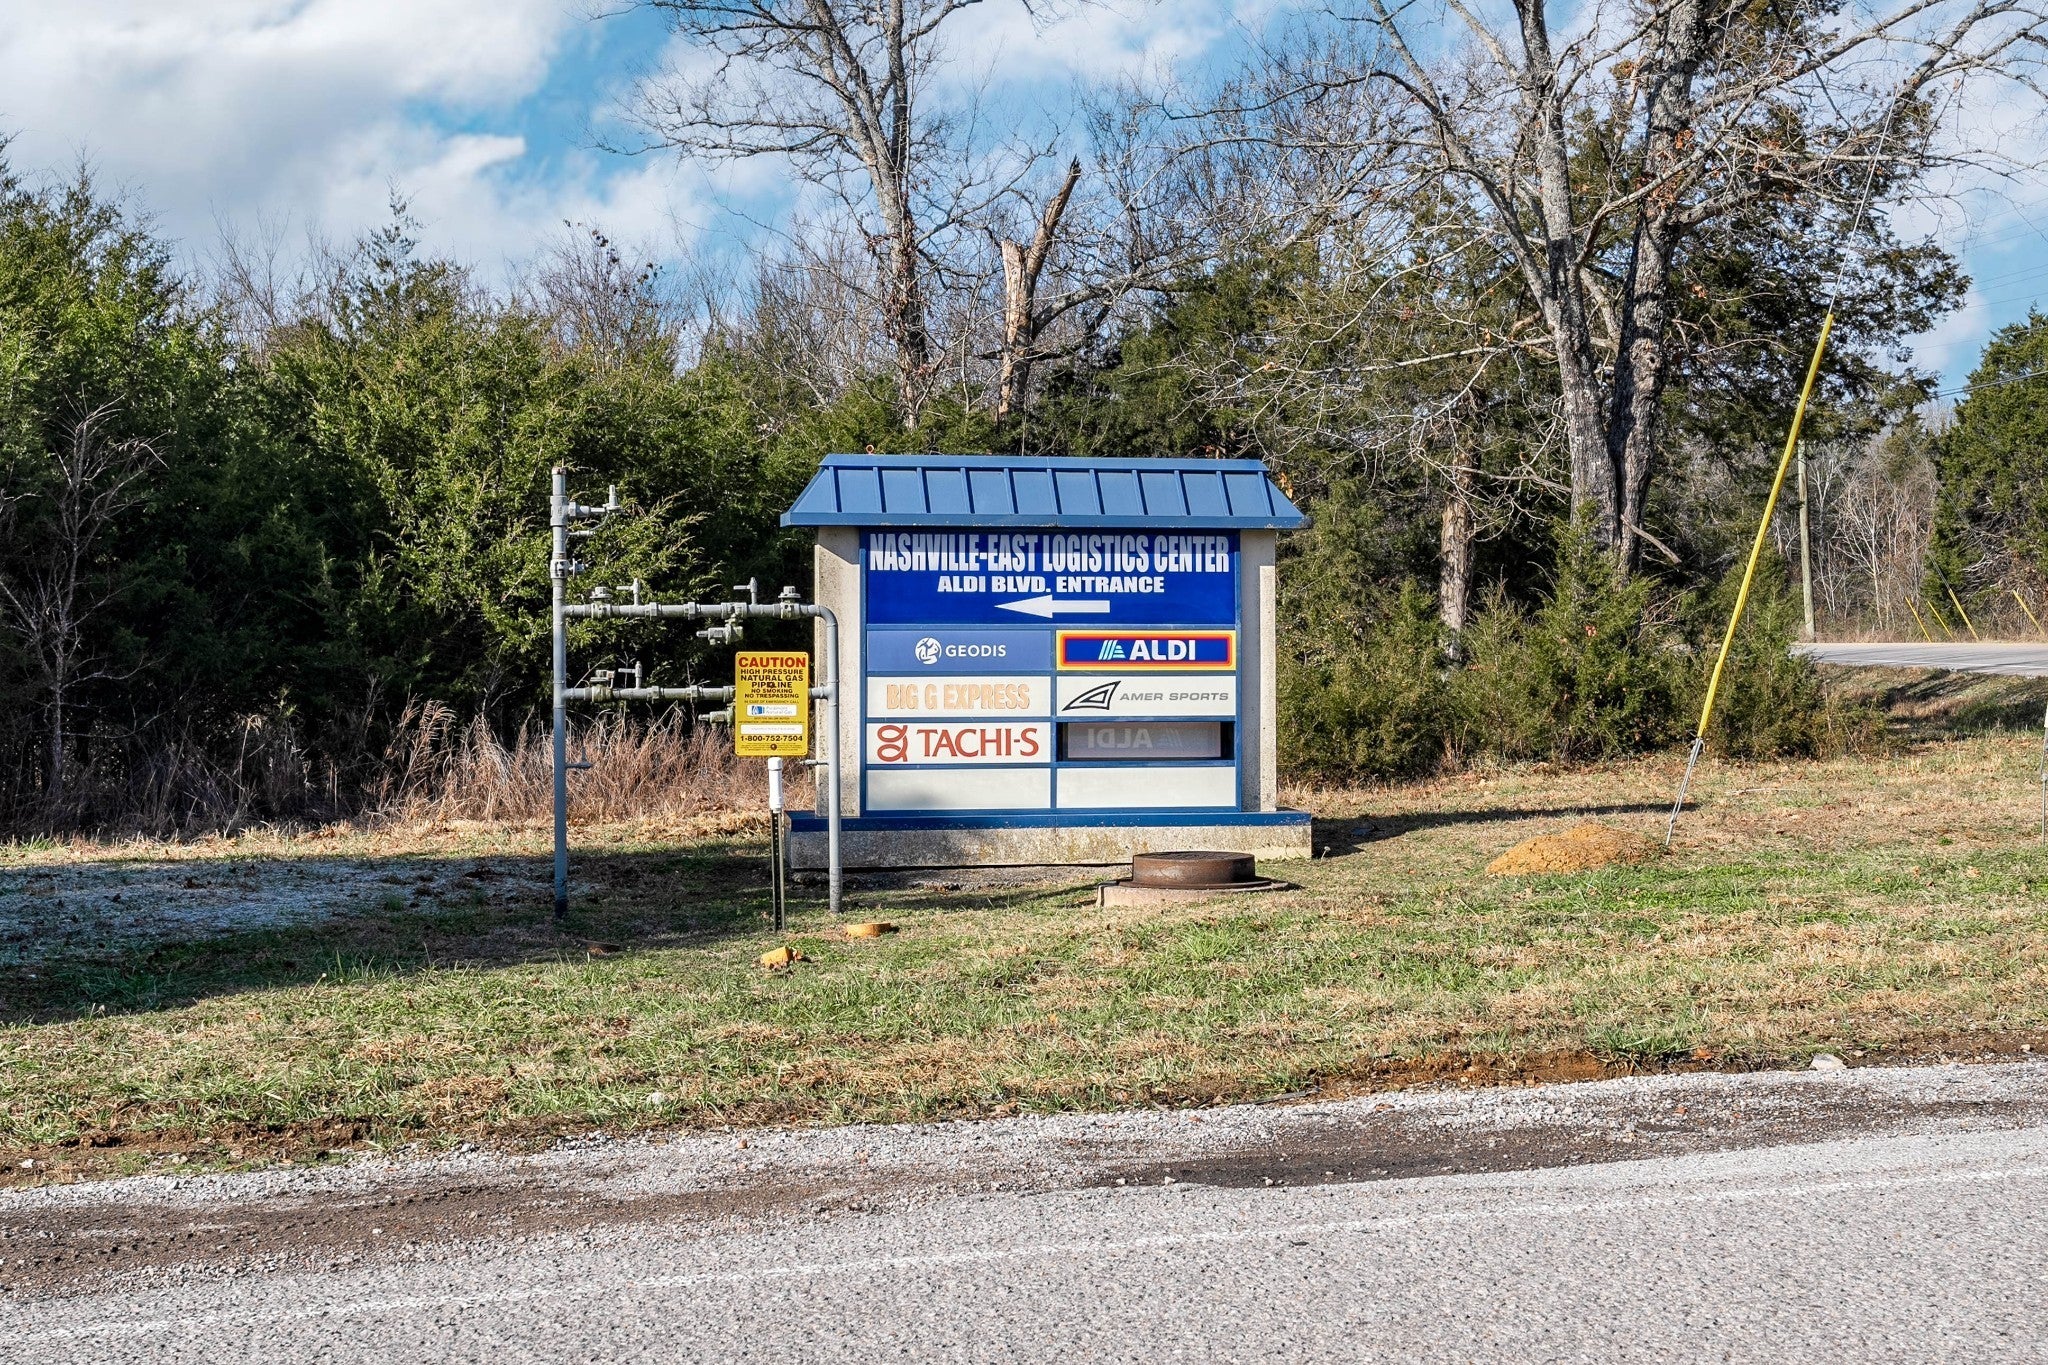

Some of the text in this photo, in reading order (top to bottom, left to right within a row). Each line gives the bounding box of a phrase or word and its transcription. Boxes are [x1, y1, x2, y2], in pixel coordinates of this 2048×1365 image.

[869, 533, 1230, 573] NASHVILLE-EAST LOGISTICS CENTER
[937, 575, 1165, 593] ALDI BLVD. ENTRANCE
[945, 644, 1007, 658] GEODIS
[1129, 639, 1197, 661] ALDI
[738, 656, 806, 668] CAUTION
[886, 683, 1031, 710] BIG G EXPRESS
[1119, 692, 1229, 702] AMER SPORTS
[916, 727, 1039, 757] TACHI-S
